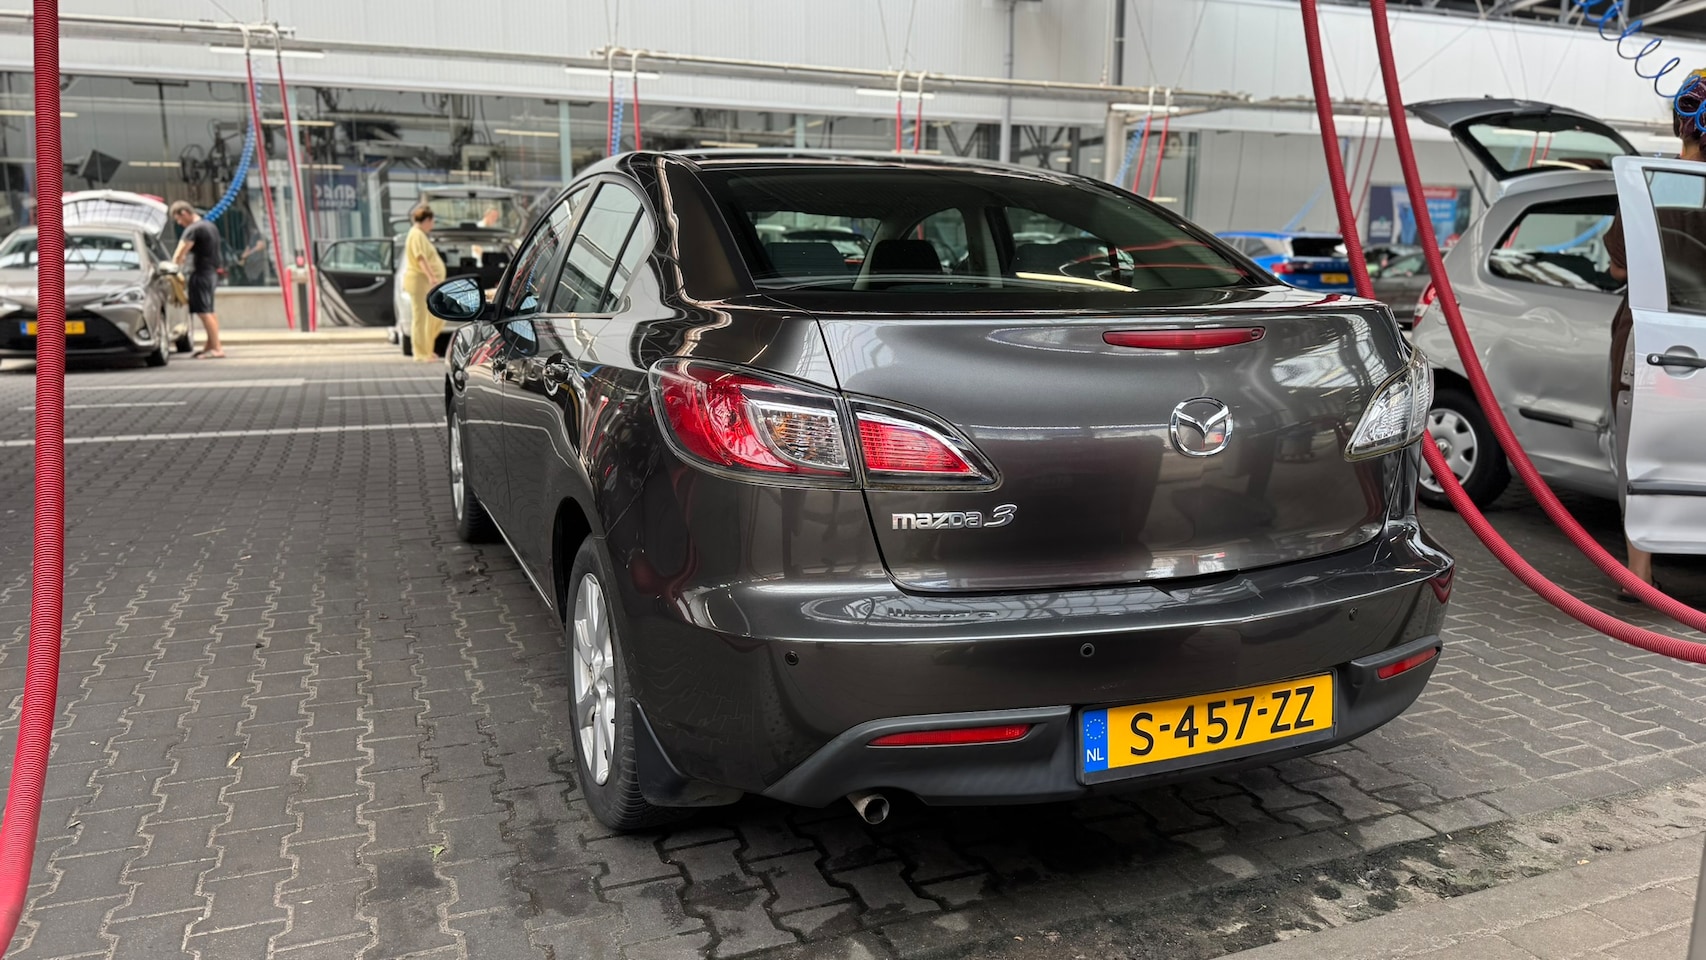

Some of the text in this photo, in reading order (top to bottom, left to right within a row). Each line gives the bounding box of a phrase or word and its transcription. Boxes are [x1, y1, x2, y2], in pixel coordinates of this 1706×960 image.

[983, 503, 1018, 527] 3
[1129, 685, 1316, 756] S-457-ZZ
[1086, 747, 1105, 763] NL
